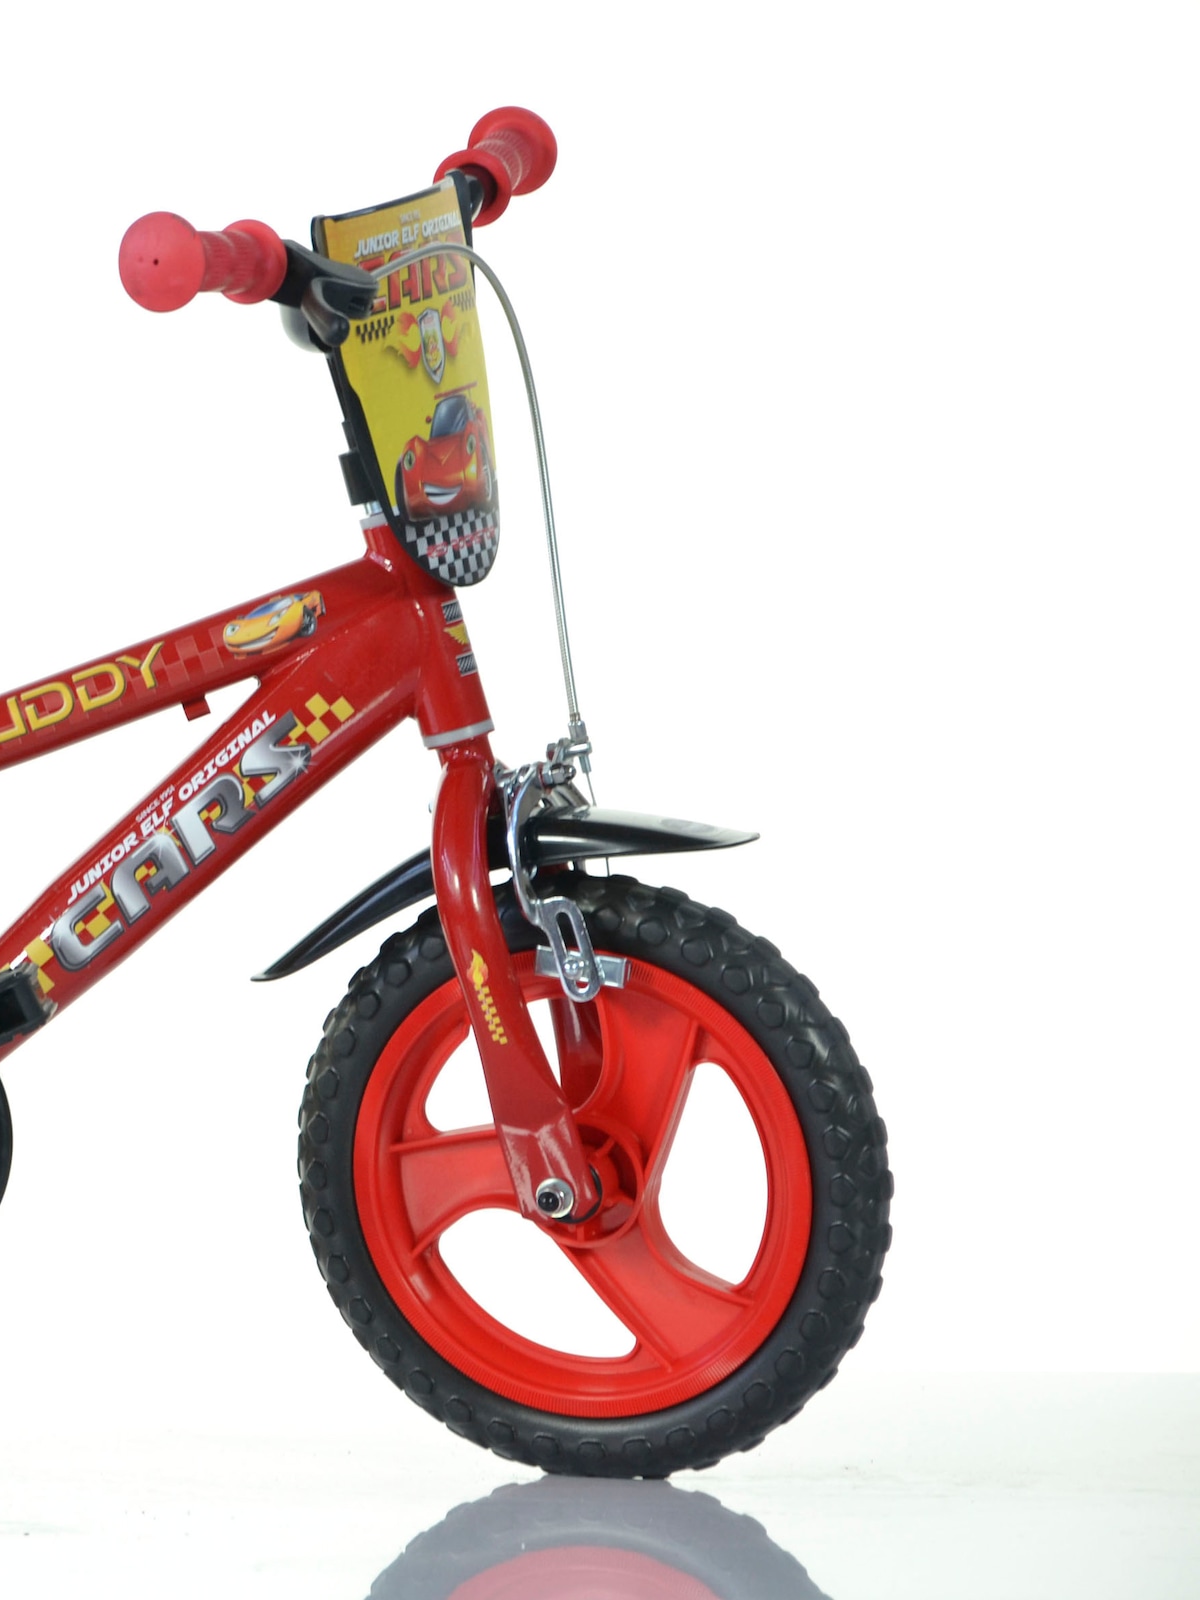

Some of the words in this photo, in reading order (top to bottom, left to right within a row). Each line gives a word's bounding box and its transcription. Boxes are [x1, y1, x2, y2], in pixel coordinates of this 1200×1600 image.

[354, 230, 399, 259] JUNIOR
[401, 223, 419, 245] ELF
[51, 709, 312, 973] CARS
[68, 831, 140, 904] JUNIOR
[140, 795, 174, 838] ELF
[178, 710, 277, 802] ORIGINAL
